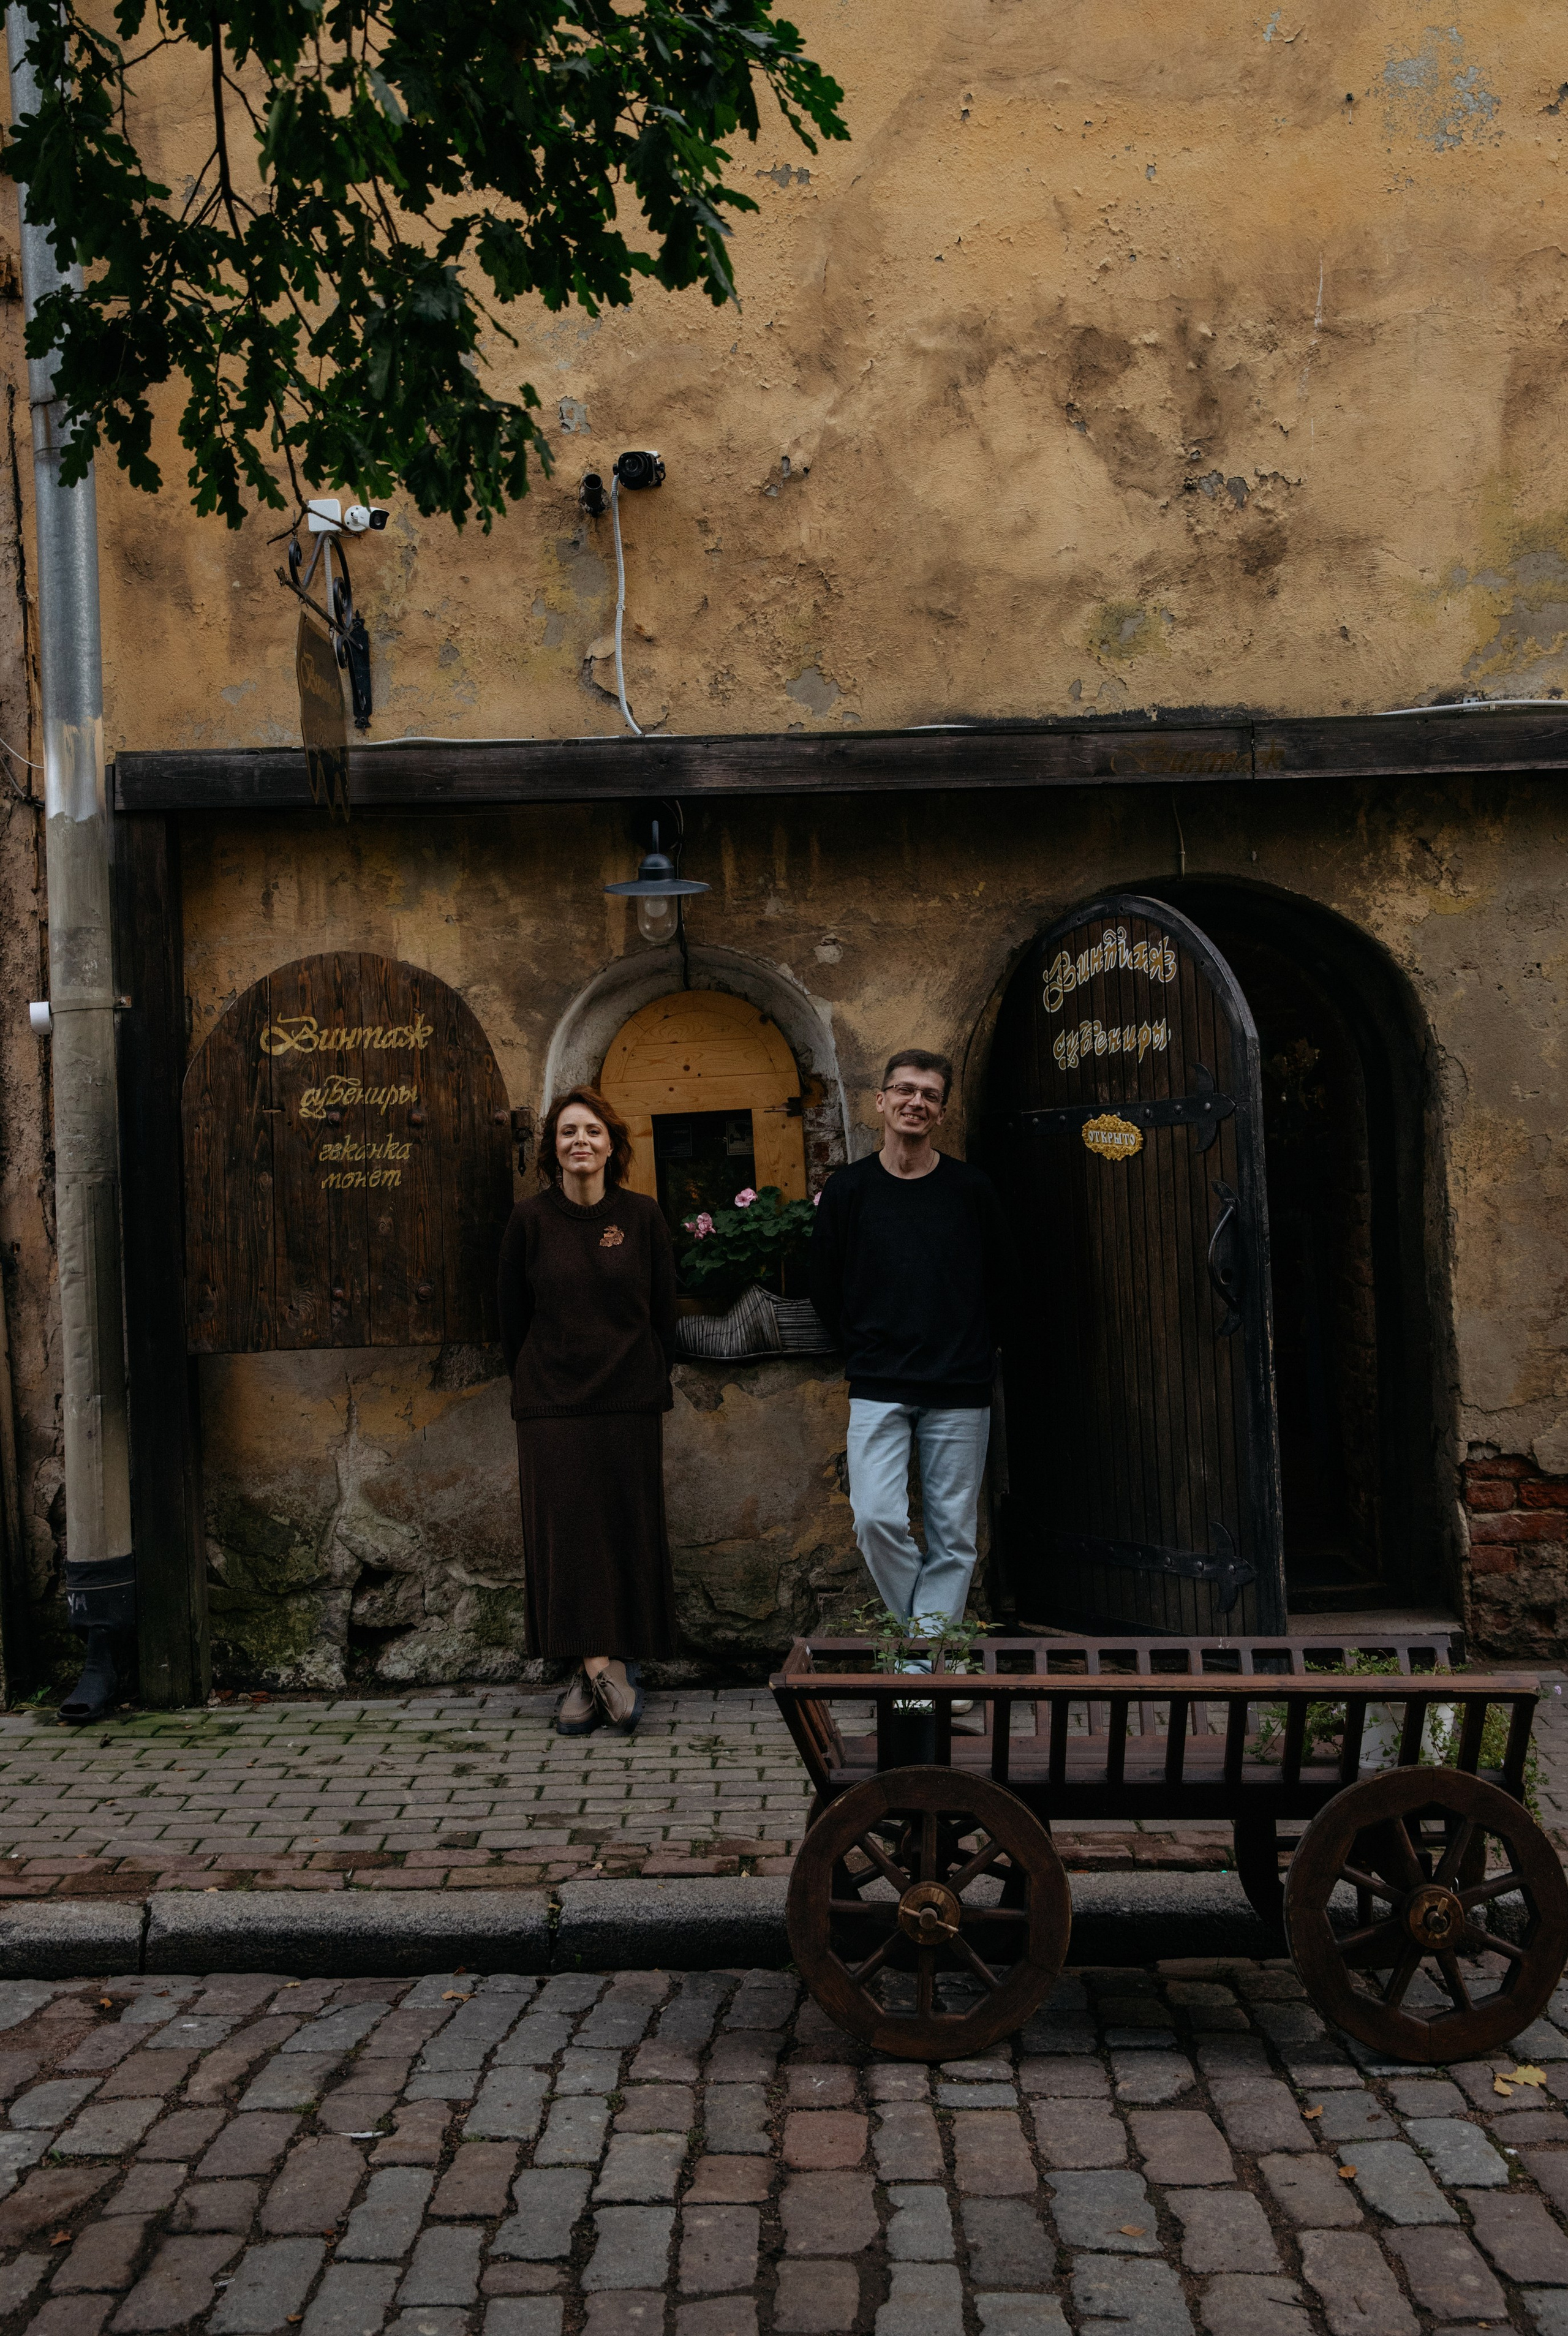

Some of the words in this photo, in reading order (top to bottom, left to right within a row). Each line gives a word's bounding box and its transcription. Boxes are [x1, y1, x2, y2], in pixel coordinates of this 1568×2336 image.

[1042, 926, 1177, 1013] Винтаж
[260, 1012, 434, 1056] Винтаж
[1053, 1018, 1171, 1071] сувениры
[299, 1074, 418, 1119] сувениры
[318, 1133, 413, 1162] чеканка
[1088, 1130, 1136, 1146] ОТКРЫТО
[321, 1168, 402, 1189] монет
